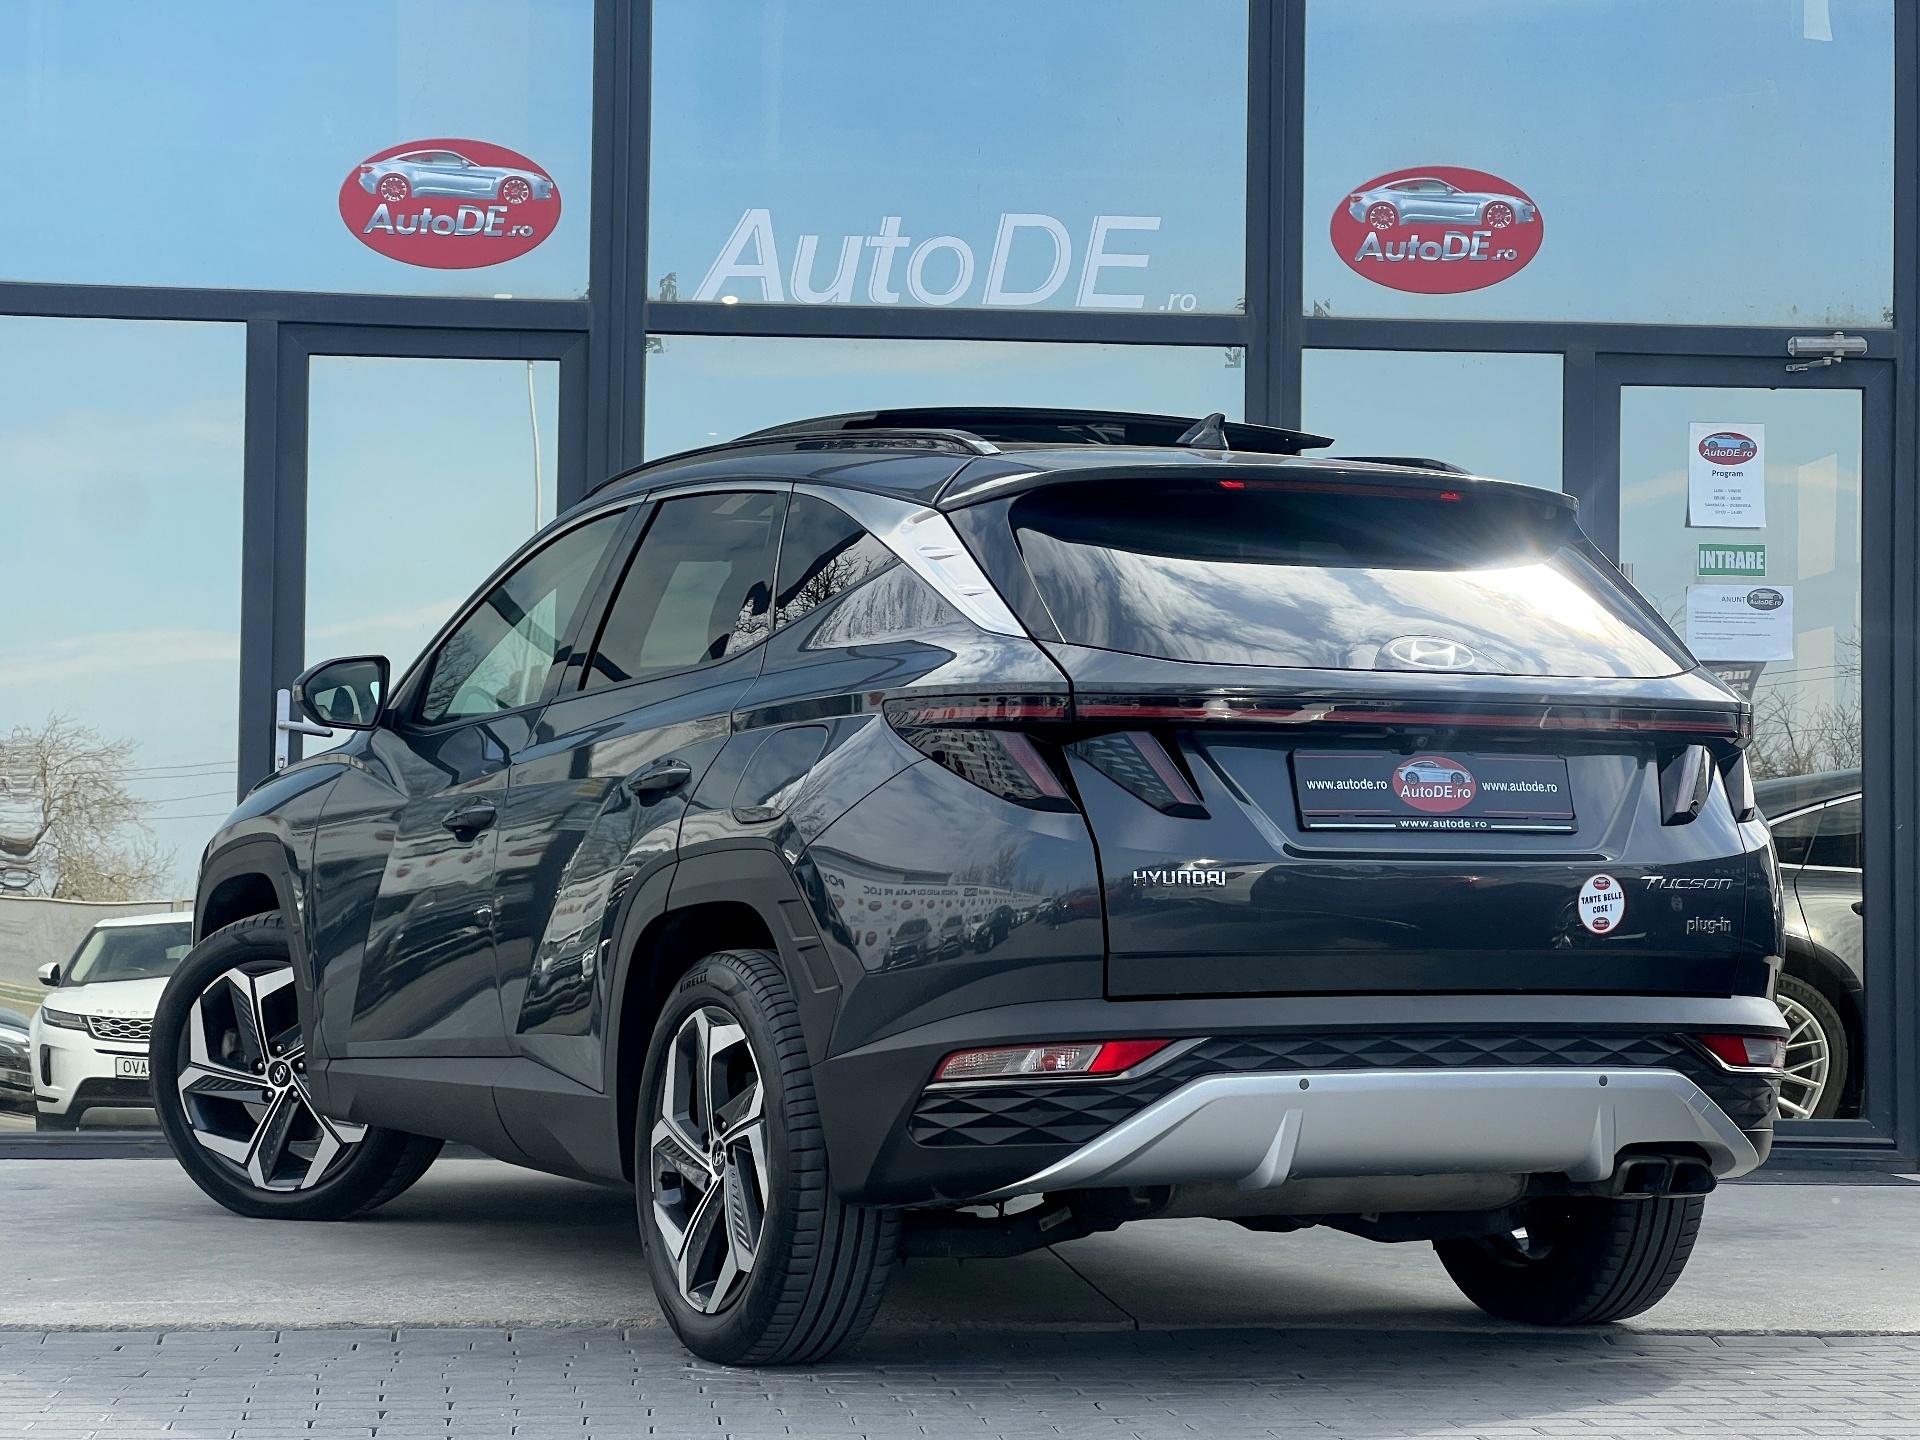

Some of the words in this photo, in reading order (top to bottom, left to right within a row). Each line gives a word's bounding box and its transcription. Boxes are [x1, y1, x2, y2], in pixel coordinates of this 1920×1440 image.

[1702, 448, 1754, 458] AutoDE.ro
[1711, 469, 1744, 478] Program
[1700, 550, 1764, 569] INTRARE
[1306, 778, 1388, 790] www.autode.ro
[1481, 780, 1558, 793] www.autode.ro
[1400, 784, 1472, 799] AutoDE.ro
[1400, 818, 1488, 829] www.autode.ro
[1133, 870, 1226, 887] HYUNDAI
[1581, 894, 1602, 905] TANTE
[1603, 891, 1623, 902] BELLE
[1592, 904, 1609, 914] COSE
[1686, 916, 1733, 935] plug-in
[679, 968, 709, 994] PIRELLI
